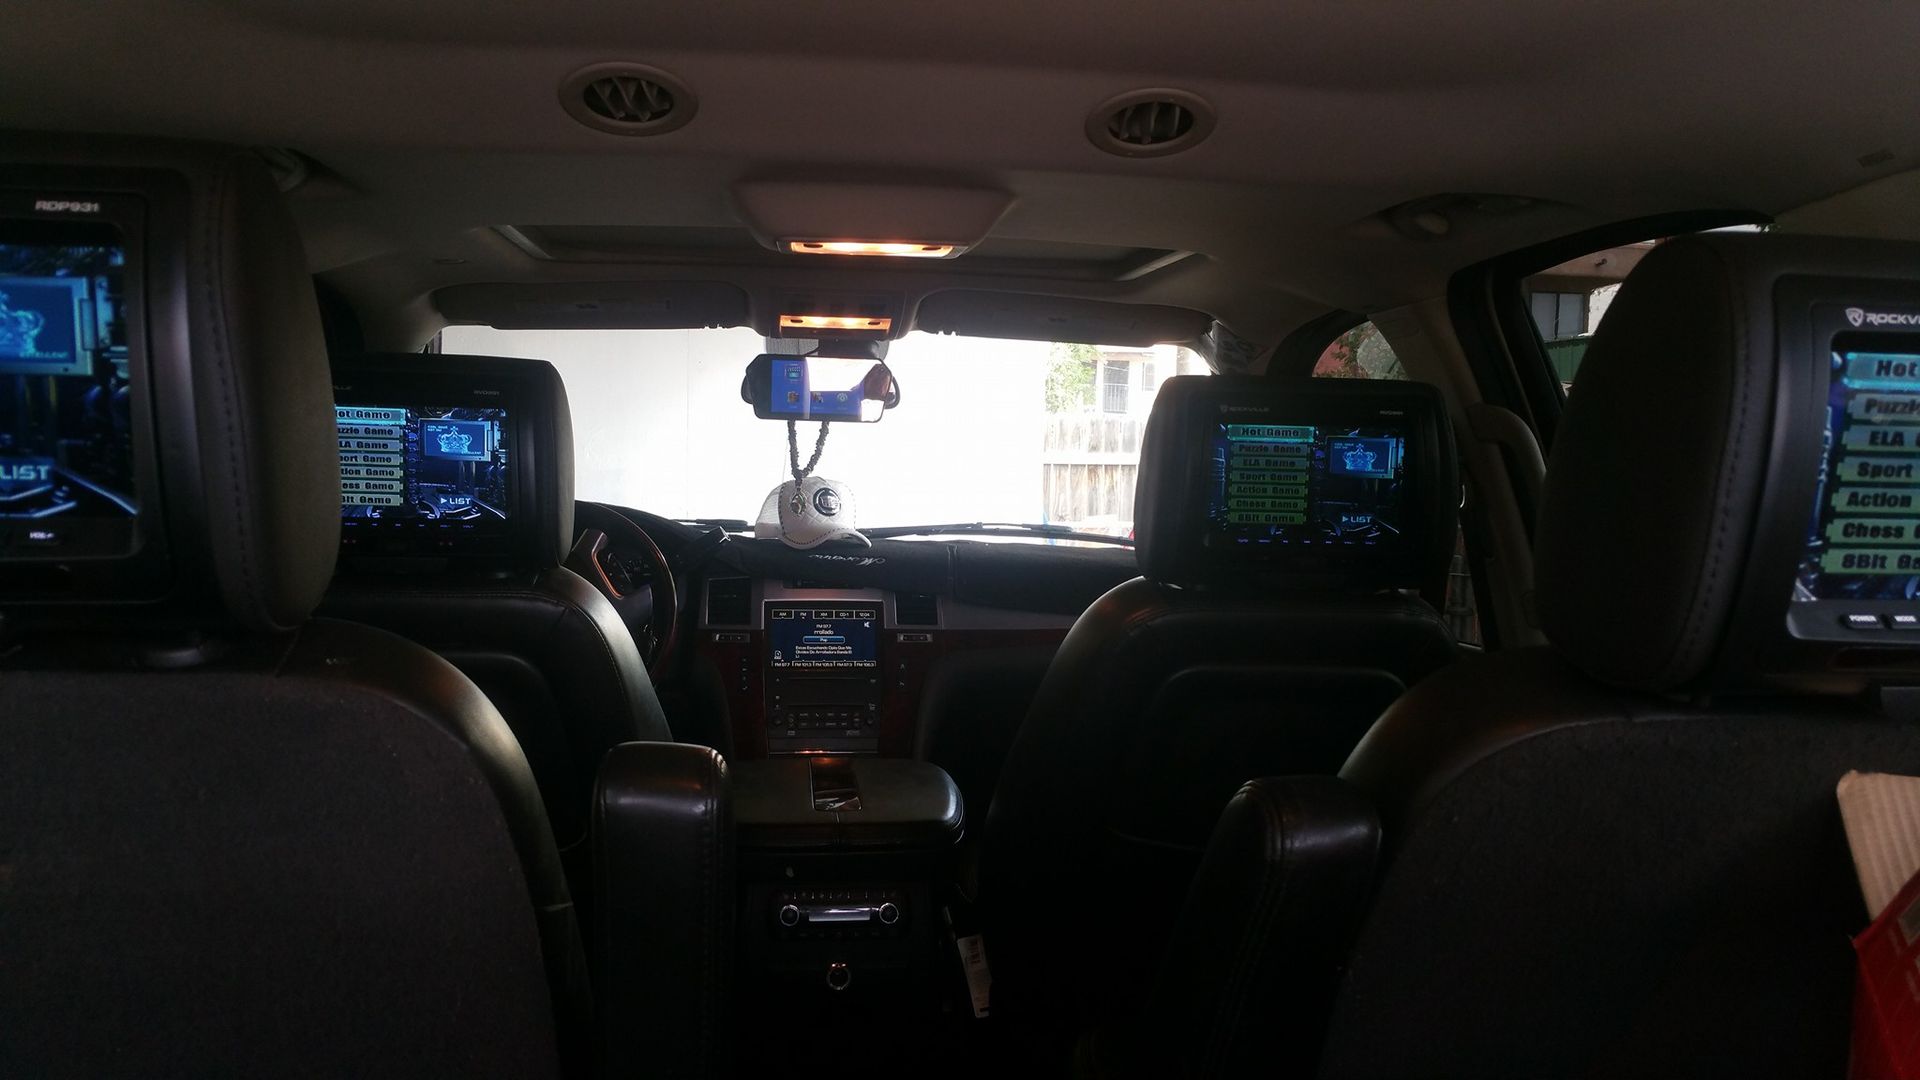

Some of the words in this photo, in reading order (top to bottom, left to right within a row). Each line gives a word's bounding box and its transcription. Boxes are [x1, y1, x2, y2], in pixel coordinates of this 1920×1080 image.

[34, 200, 101, 213] RDP931
[1875, 360, 1918, 377] Hot
[356, 410, 391, 419] Game
[364, 428, 394, 436] Game
[1241, 427, 1262, 436] Hot
[1266, 428, 1299, 437] Game
[1868, 431, 1905, 447] ELA
[357, 441, 389, 450] Game
[1238, 444, 1269, 453] Puzzle
[1273, 445, 1302, 453] Game
[363, 455, 392, 463] Game
[1265, 459, 1296, 468] Game
[0, 465, 49, 481] LIST
[366, 468, 395, 477] Game
[1857, 462, 1913, 479] Sport
[1239, 472, 1266, 481] Sport
[1270, 473, 1298, 481] Game
[365, 482, 394, 491] Game
[1236, 486, 1268, 495] Action
[1272, 487, 1300, 495] Game
[360, 496, 392, 504] Game
[449, 497, 471, 505] LIST
[1846, 491, 1912, 508] Action
[1236, 500, 1266, 509] Chess
[1270, 501, 1298, 509] Game
[1265, 514, 1295, 522] Game
[1842, 522, 1905, 539] Chess
[1842, 553, 1888, 570] 8Bit
